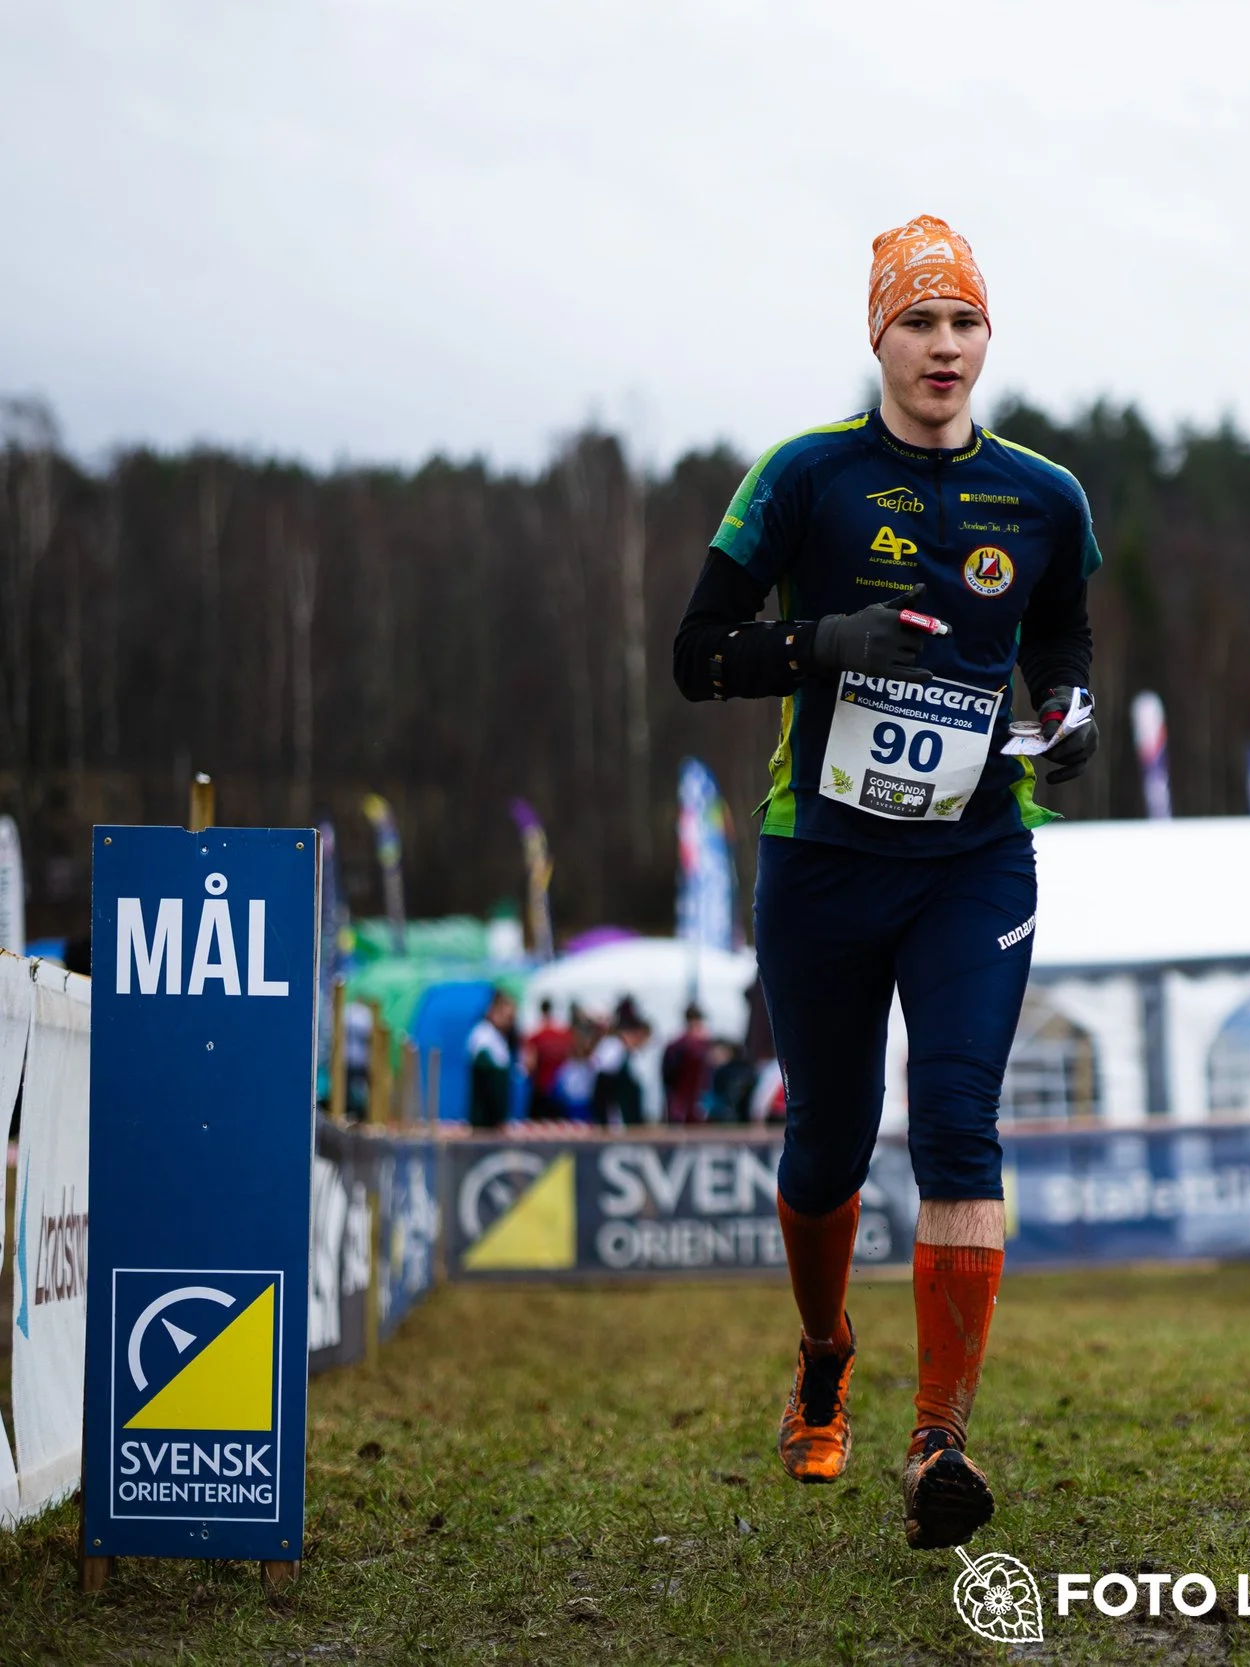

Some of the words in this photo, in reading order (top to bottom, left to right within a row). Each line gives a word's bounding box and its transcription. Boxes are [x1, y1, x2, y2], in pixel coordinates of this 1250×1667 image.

[877, 495, 925, 513] aefab
[857, 696, 929, 719] KOLMÅRDSMEDELN
[930, 713, 939, 722] SL
[941, 716, 952, 725] #2
[953, 719, 973, 729] 2026
[870, 721, 944, 774] 90
[869, 777, 927, 797] GODKÄNDA
[116, 872, 289, 996] MÅL
[119, 1441, 272, 1478] SVENSK
[118, 1481, 273, 1505] ORIENTERING
